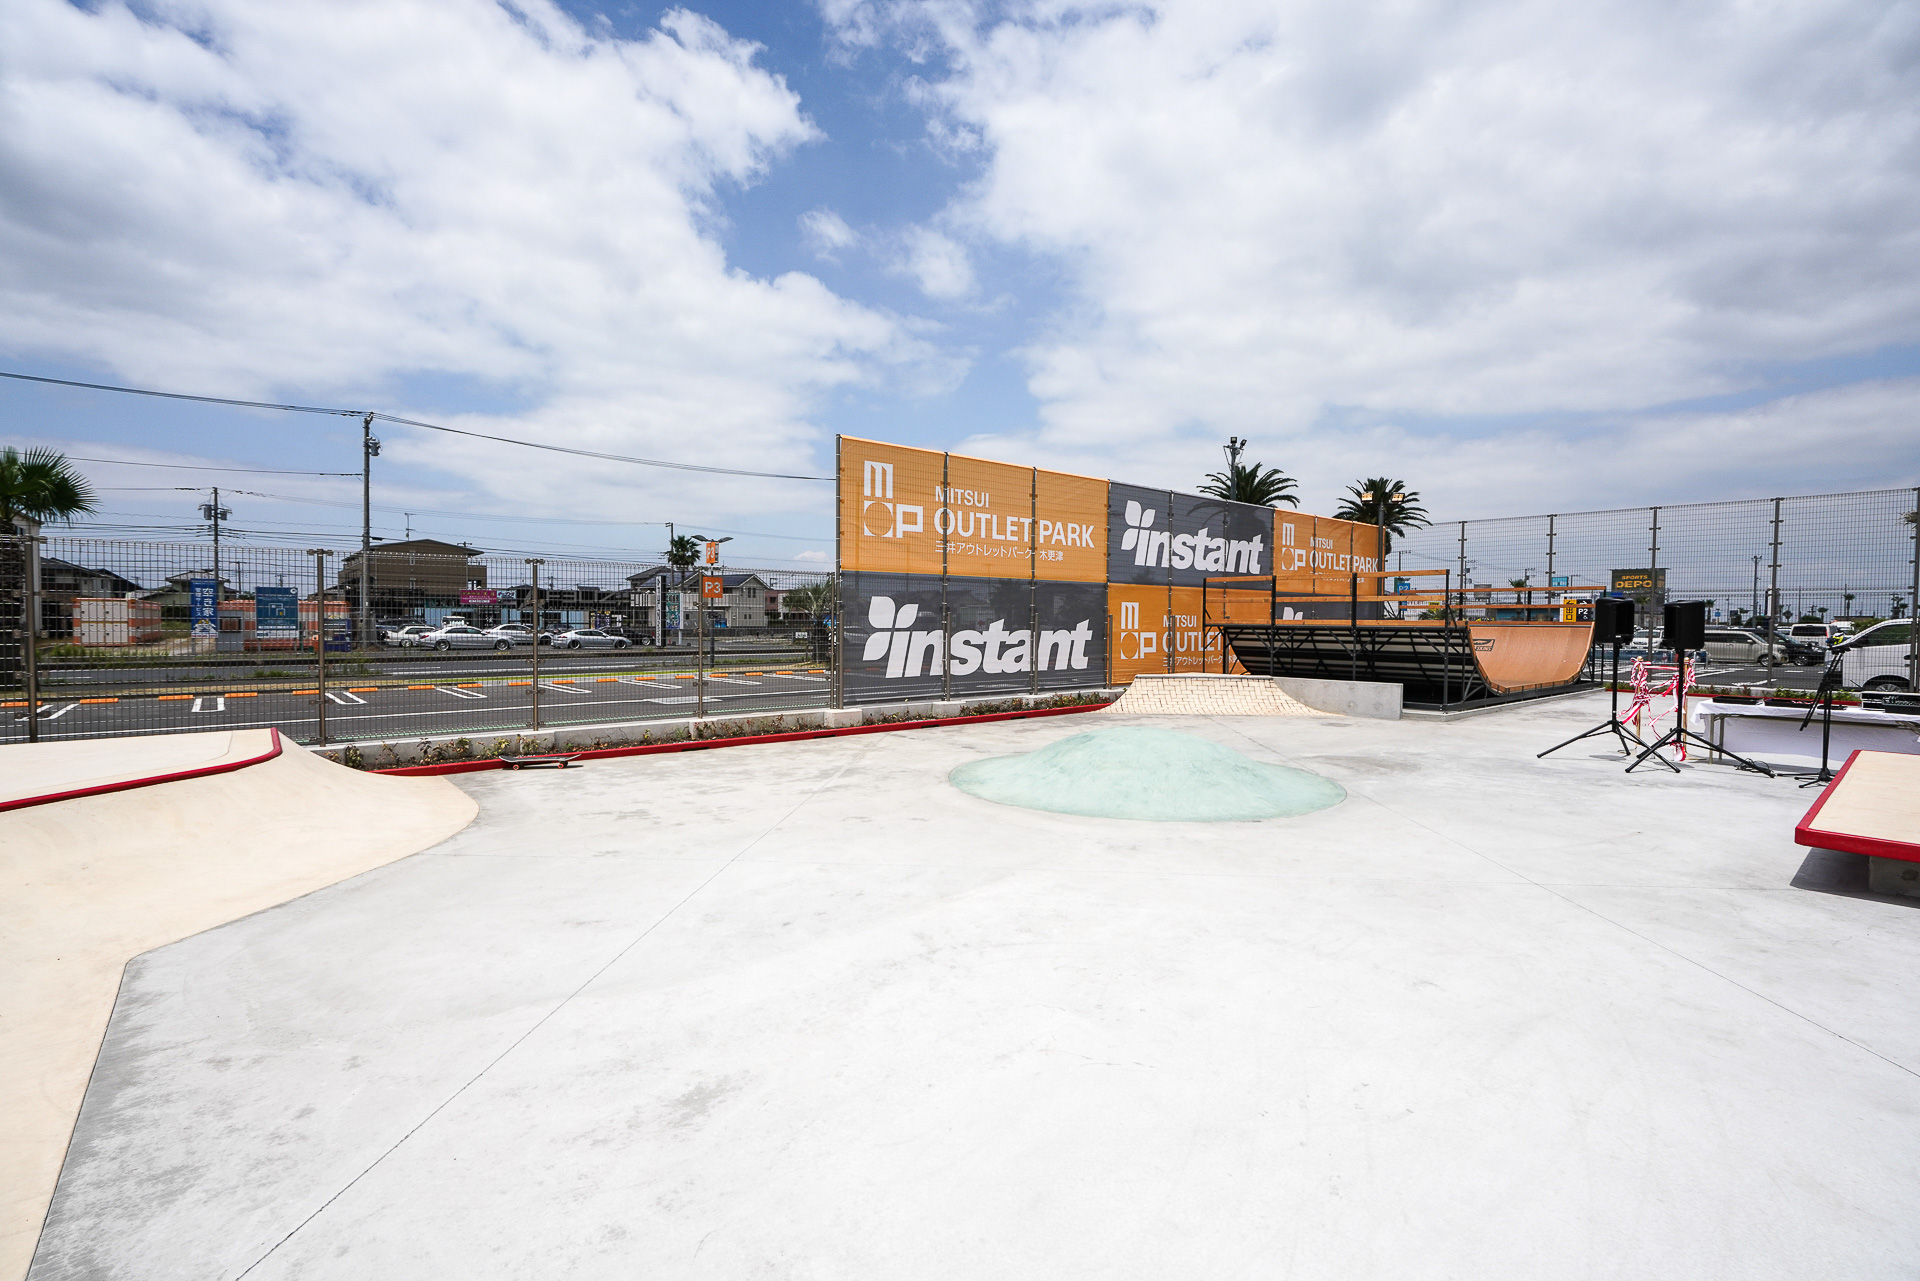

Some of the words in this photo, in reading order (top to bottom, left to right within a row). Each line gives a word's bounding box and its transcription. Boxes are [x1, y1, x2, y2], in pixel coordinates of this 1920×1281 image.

[935, 485, 990, 508] MITSUI
[934, 507, 1033, 542] OUTLET
[1039, 519, 1095, 548] PARK
[1124, 500, 1264, 575] instant
[706, 547, 715, 559] P3
[935, 540, 1032, 560] 三井アウトレットパーク
[1039, 549, 1064, 562] 木更津
[1309, 536, 1334, 550] MITSUI
[1309, 550, 1352, 571] OUTLET
[1353, 555, 1379, 573] PARK
[704, 581, 721, 594] P3
[1616, 580, 1653, 588] DEPO
[202, 587, 214, 617] 空き家
[1163, 615, 1197, 628] MTSUI
[866, 596, 1093, 678] instant
